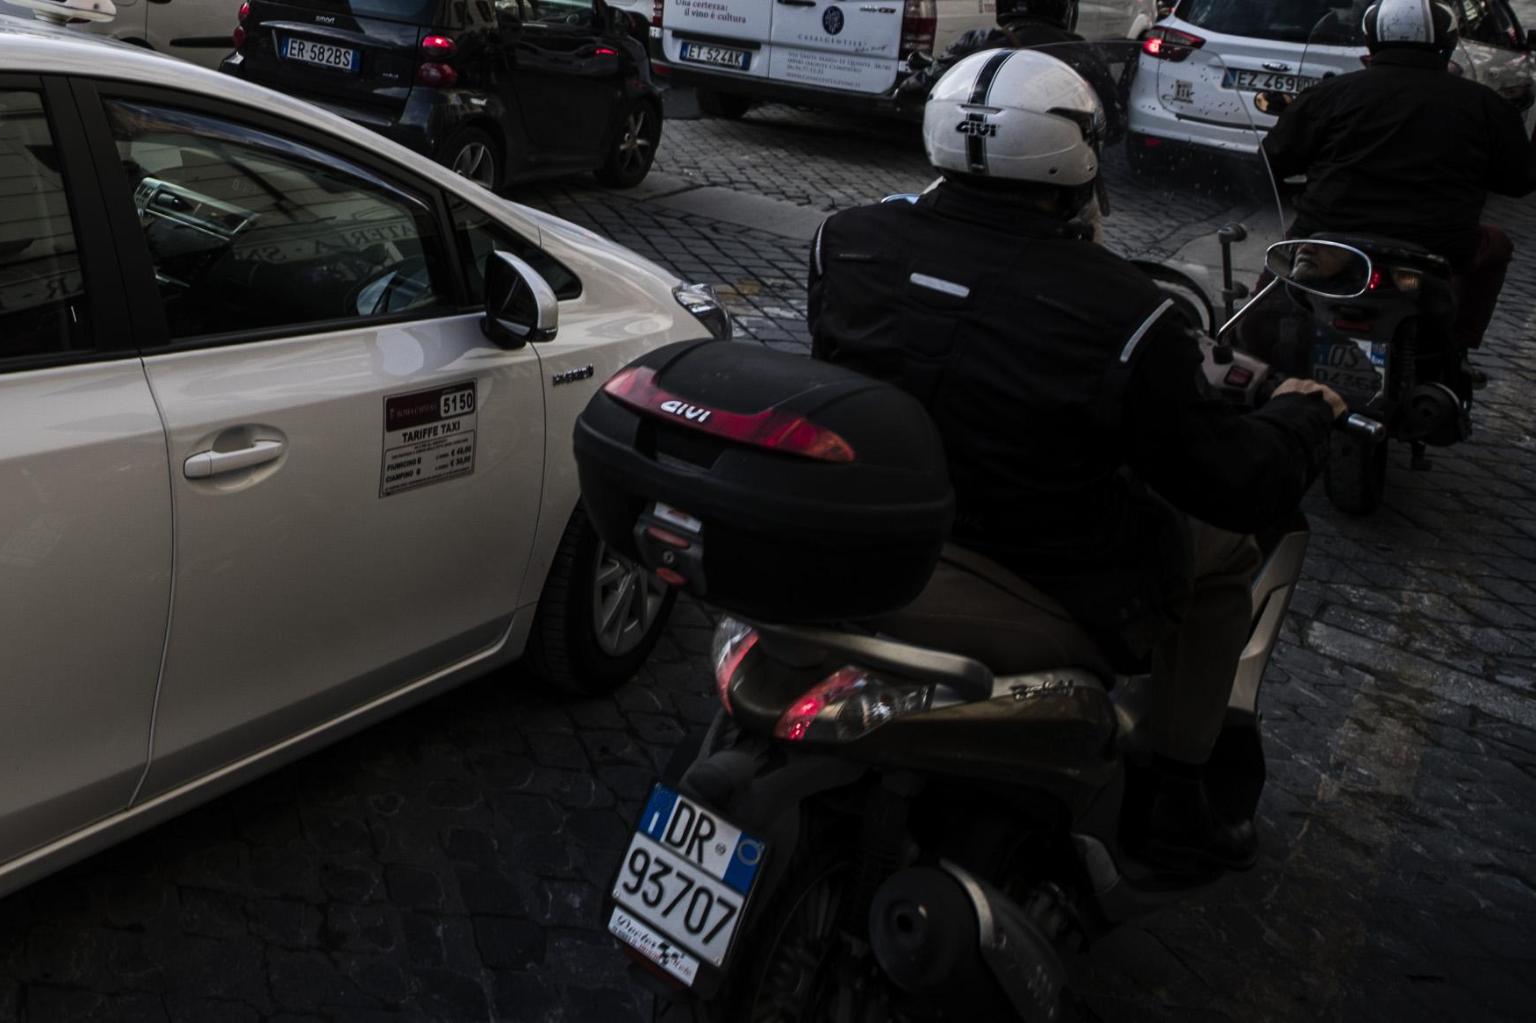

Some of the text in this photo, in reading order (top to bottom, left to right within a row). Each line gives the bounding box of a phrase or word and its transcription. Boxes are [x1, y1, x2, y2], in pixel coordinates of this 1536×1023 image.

[684, 8, 690, 16] il
[690, 9, 709, 18] vino
[717, 12, 746, 24] cultura
[289, 39, 351, 68] ER 582BS
[1237, 72, 1258, 87] EZ
[955, 120, 996, 138] GIVI
[443, 392, 473, 414] 5150
[660, 400, 711, 423] GIVI
[402, 421, 460, 443] TARIFFE TAXI
[665, 800, 716, 864] DR
[622, 848, 738, 944] 93707
